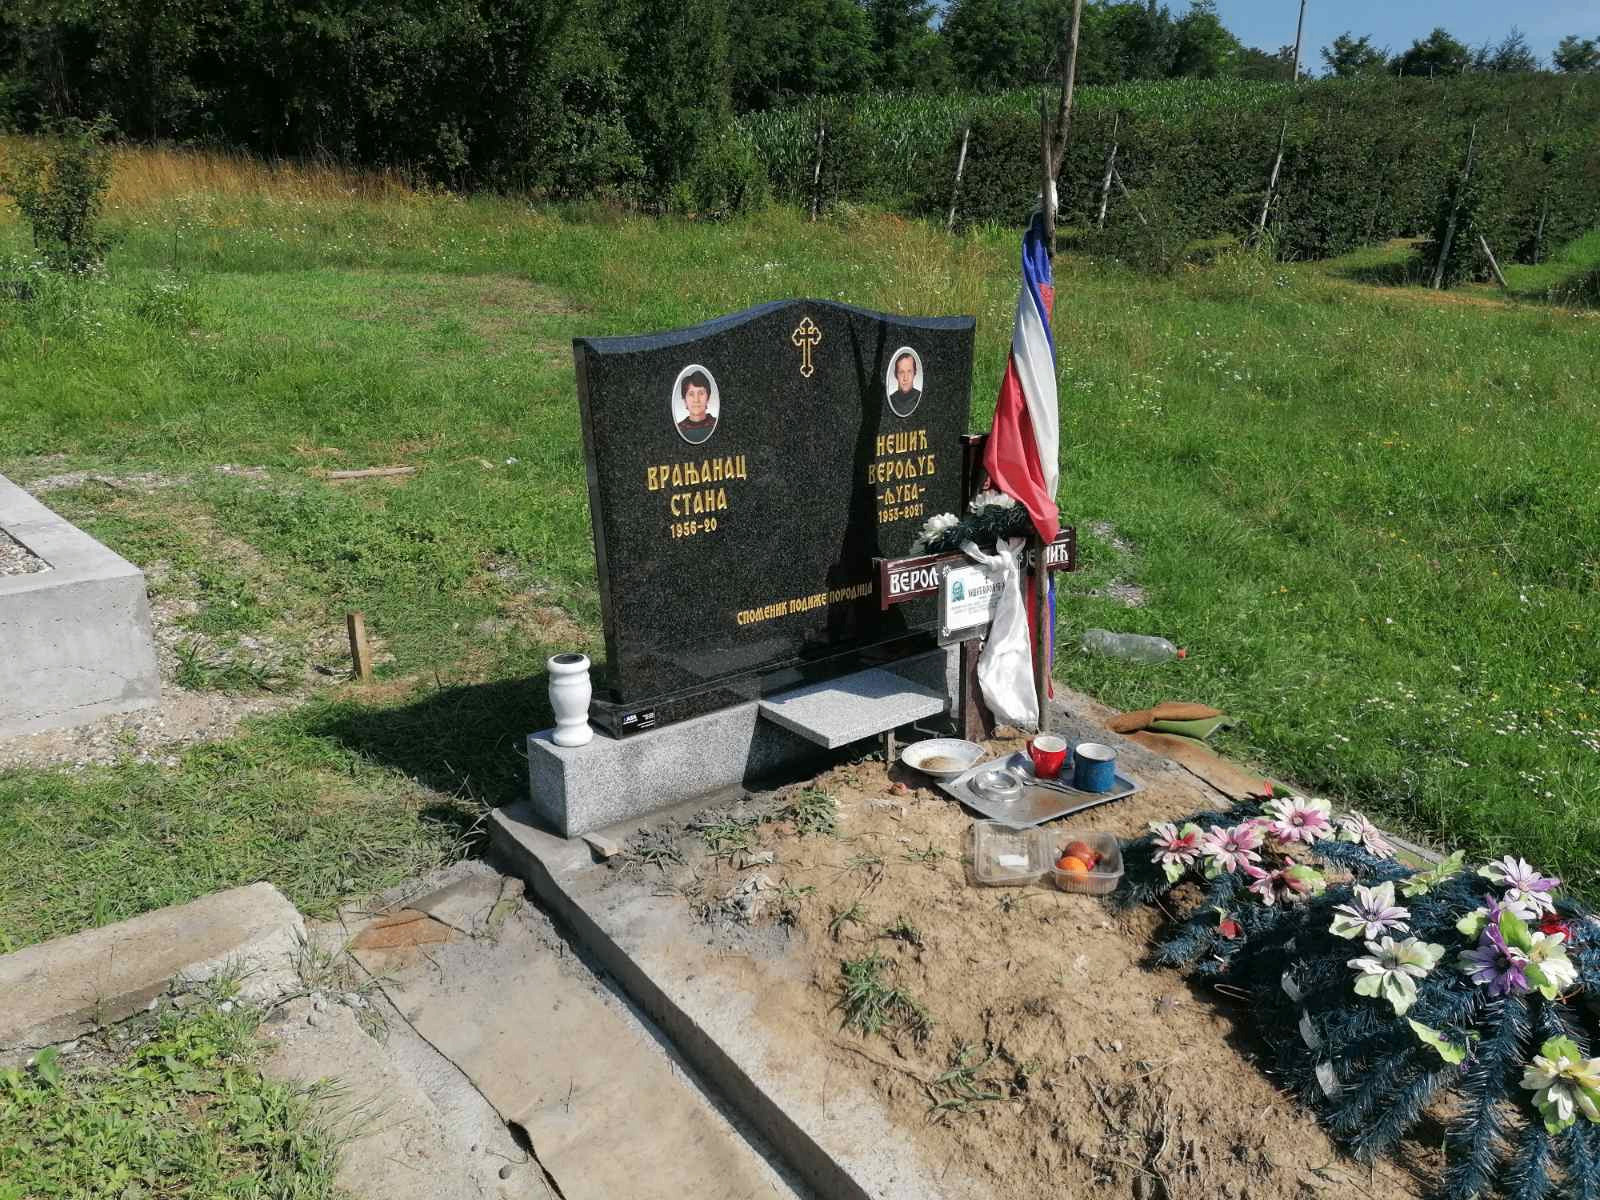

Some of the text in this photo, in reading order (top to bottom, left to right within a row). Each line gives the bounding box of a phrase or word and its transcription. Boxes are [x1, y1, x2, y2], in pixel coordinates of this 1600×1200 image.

[876, 430, 928, 456] НЕШИЋ
[647, 454, 747, 491] ВРАЊАНАЦ
[868, 454, 936, 485] ВЕРОЉУБ
[671, 488, 728, 516] СТАНА
[670, 517, 718, 538] 1956-20
[737, 581, 873, 625] СПОМЕНИК ПОДИЖЕ ПОРОДИЦА
